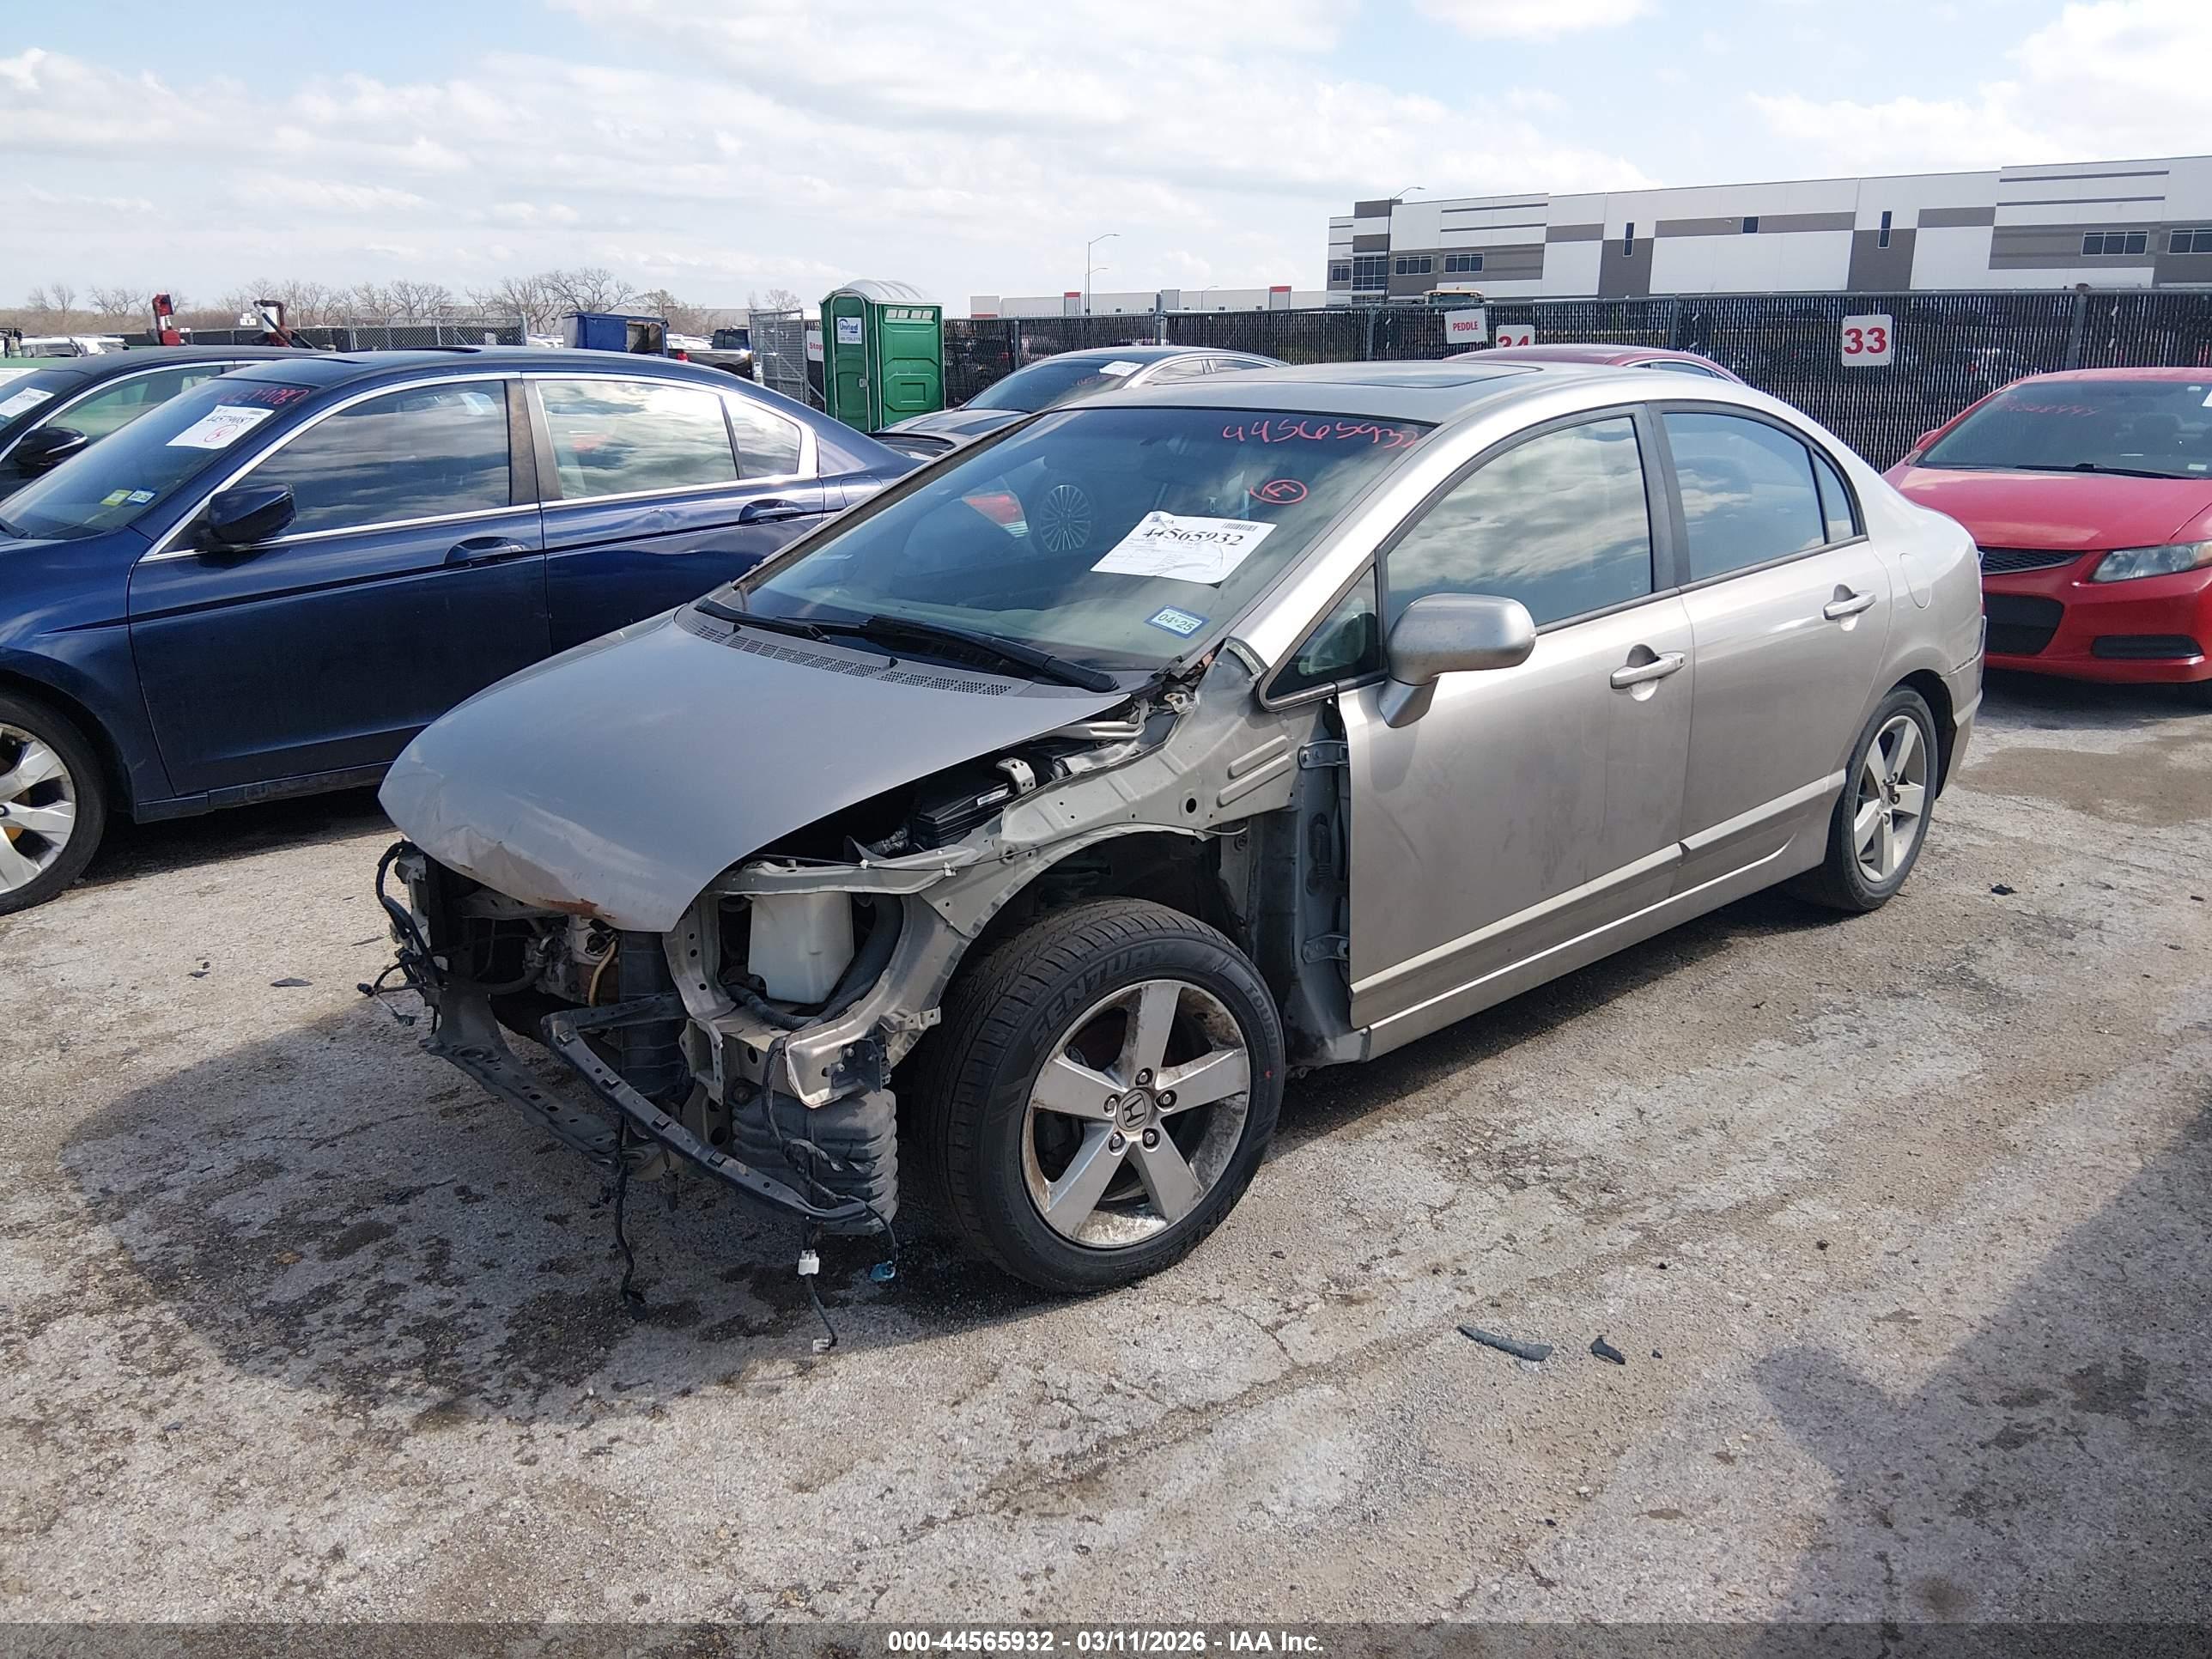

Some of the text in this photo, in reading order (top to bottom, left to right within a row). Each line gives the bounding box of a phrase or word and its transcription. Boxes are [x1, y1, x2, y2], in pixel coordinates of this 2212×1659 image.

[1453, 321, 1479, 331] PEDDLE
[809, 342, 823, 350] Stop
[1844, 327, 1887, 354] 33
[1143, 527, 1244, 546] 44565932
[1158, 613, 1195, 631] 04 25
